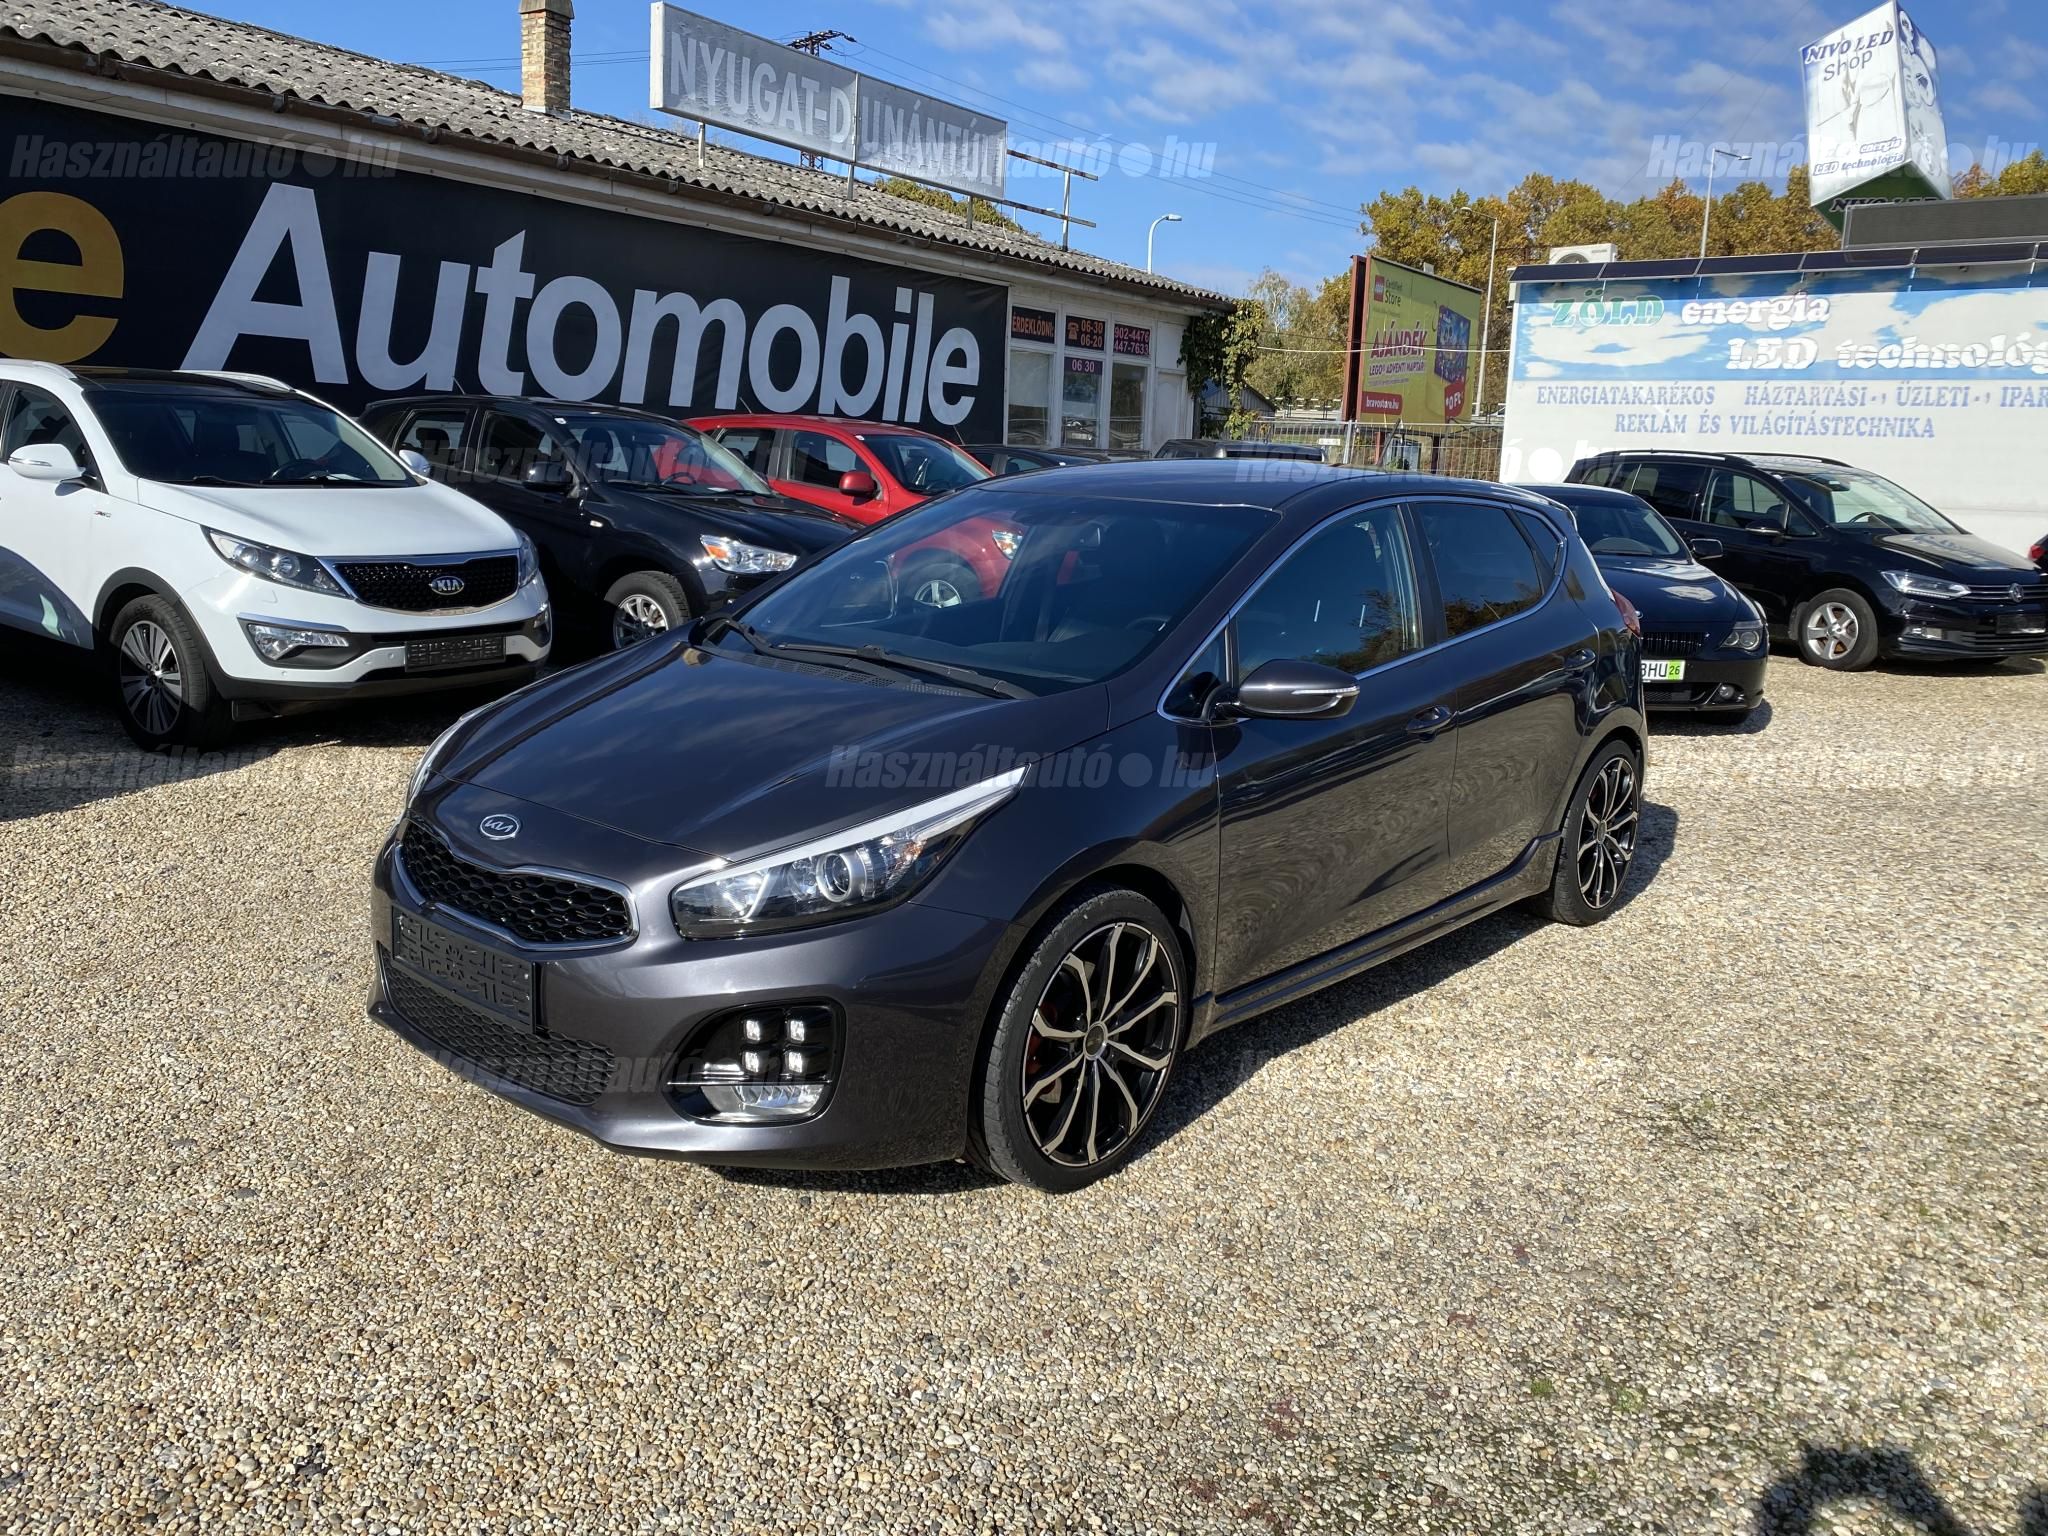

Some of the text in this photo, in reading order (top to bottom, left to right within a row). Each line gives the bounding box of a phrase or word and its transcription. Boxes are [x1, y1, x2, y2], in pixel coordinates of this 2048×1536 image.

[1805, 30, 1895, 64] NIVO LED
[180, 182, 980, 425] Automobile
[1550, 289, 1665, 328] ZÖLD
[1370, 320, 1428, 359] AJÁNDÉK
[1726, 336, 1818, 370] LED
[1071, 359, 1095, 373] 06 30
[1537, 382, 1716, 405] ENERGIATAKARÉKOS
[1614, 409, 1935, 438] REKLÁM ÉS VILÁGÍTÁSTECHNIKA
[436, 579, 460, 591] KIA
[1669, 665, 1681, 676] 26
